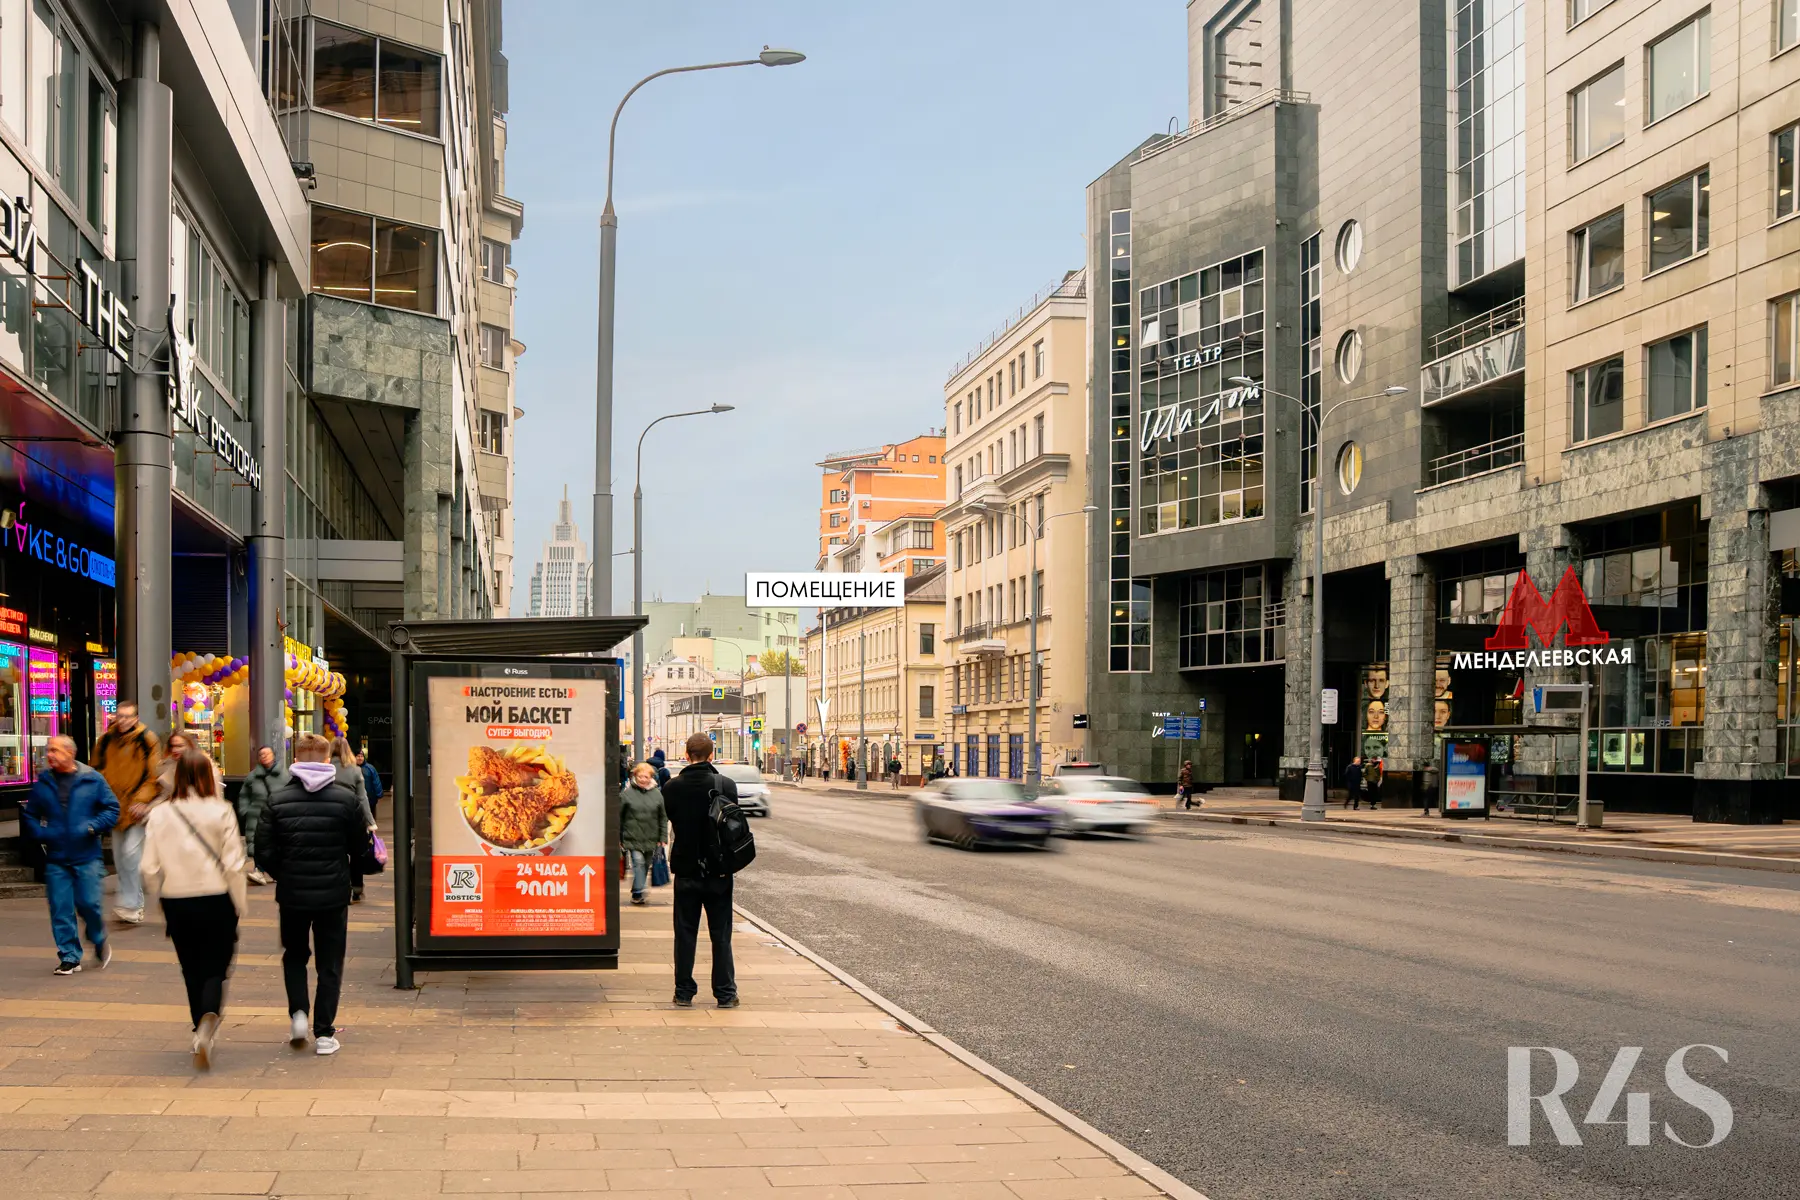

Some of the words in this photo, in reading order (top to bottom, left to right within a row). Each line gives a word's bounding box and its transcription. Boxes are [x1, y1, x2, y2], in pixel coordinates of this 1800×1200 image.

[77, 258, 129, 362] THE
[1174, 347, 1222, 371] ТЕАТР
[211, 415, 261, 491] РЕСТОРАН
[470, 686, 535, 698] НАСТРОЕНИЕ
[539, 688, 567, 698] ЕСТЬ!
[466, 700, 502, 723] МОЙ
[508, 706, 572, 724] БАСКЕТ
[488, 728, 512, 737] СУПЕР
[513, 729, 551, 738] ВЫГОДНО
[517, 863, 533, 876] 24
[535, 864, 568, 876] ЧАСА
